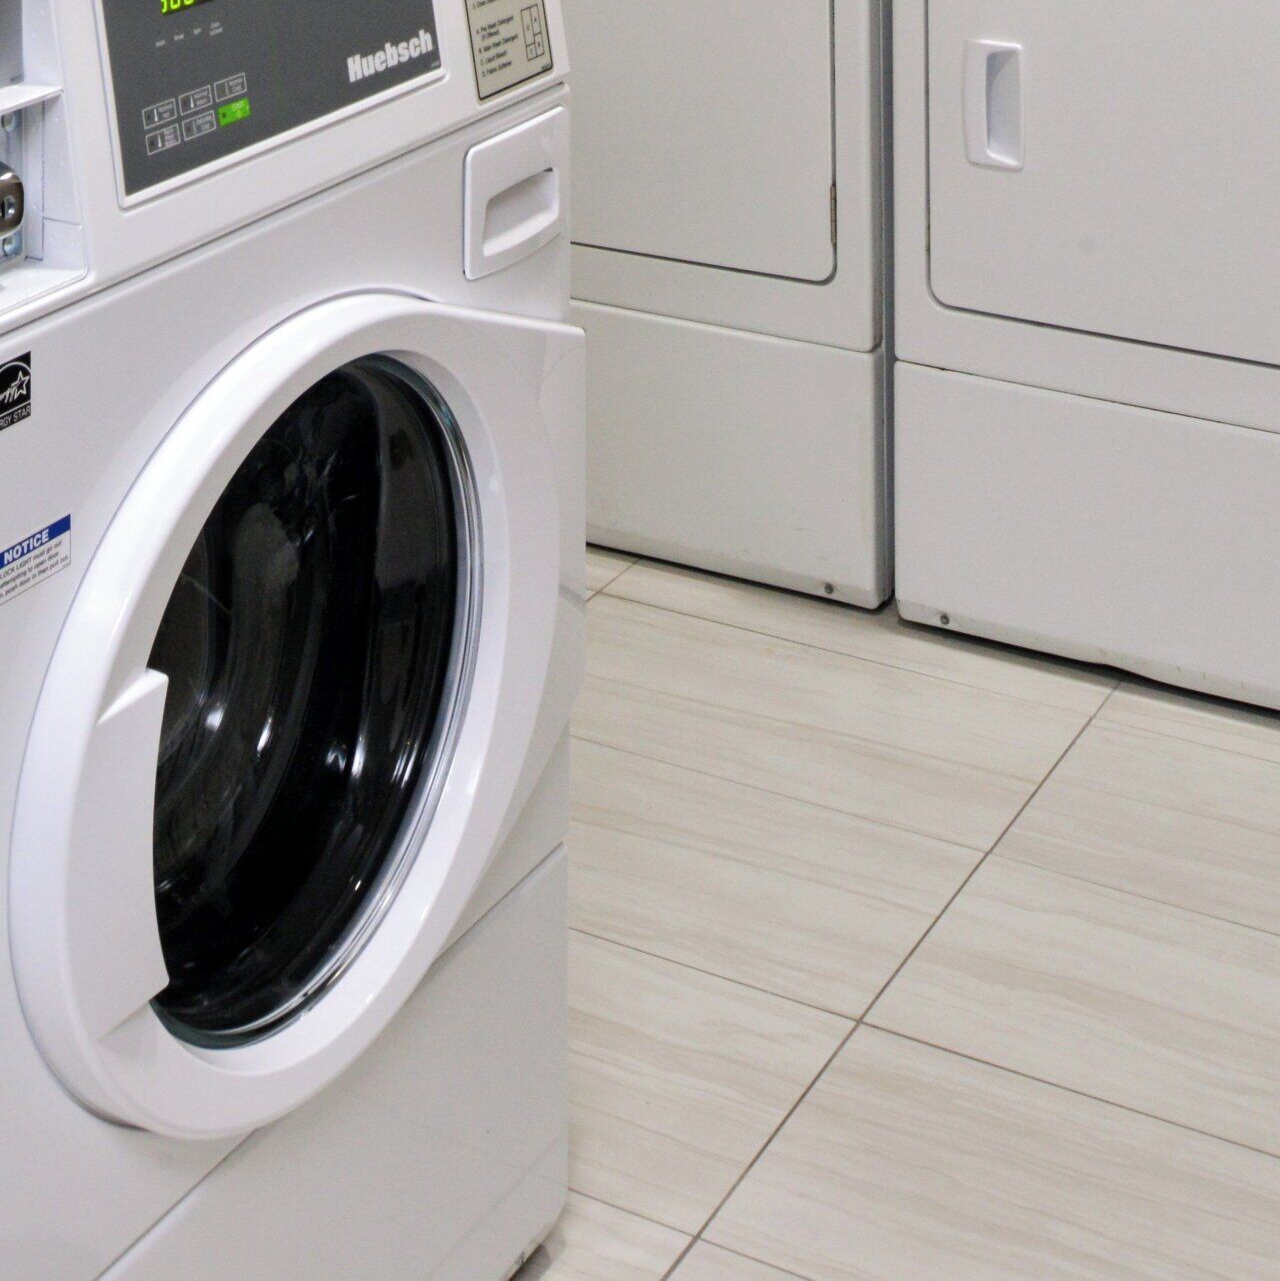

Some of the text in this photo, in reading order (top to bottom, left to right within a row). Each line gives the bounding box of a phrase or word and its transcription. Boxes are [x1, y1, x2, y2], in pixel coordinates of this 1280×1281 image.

[347, 29, 433, 83] Huebsch
[13, 405, 31, 422] STAR
[3, 528, 49, 565] NOTICE
[0, 567, 14, 579] LOCK
[16, 556, 32, 570] LIGHT
[33, 549, 45, 560] must
[0, 569, 27, 589] attempting
[34, 558, 46, 569] open
[47, 551, 58, 561] door
[5, 584, 17, 595] push
[18, 576, 30, 586] door
